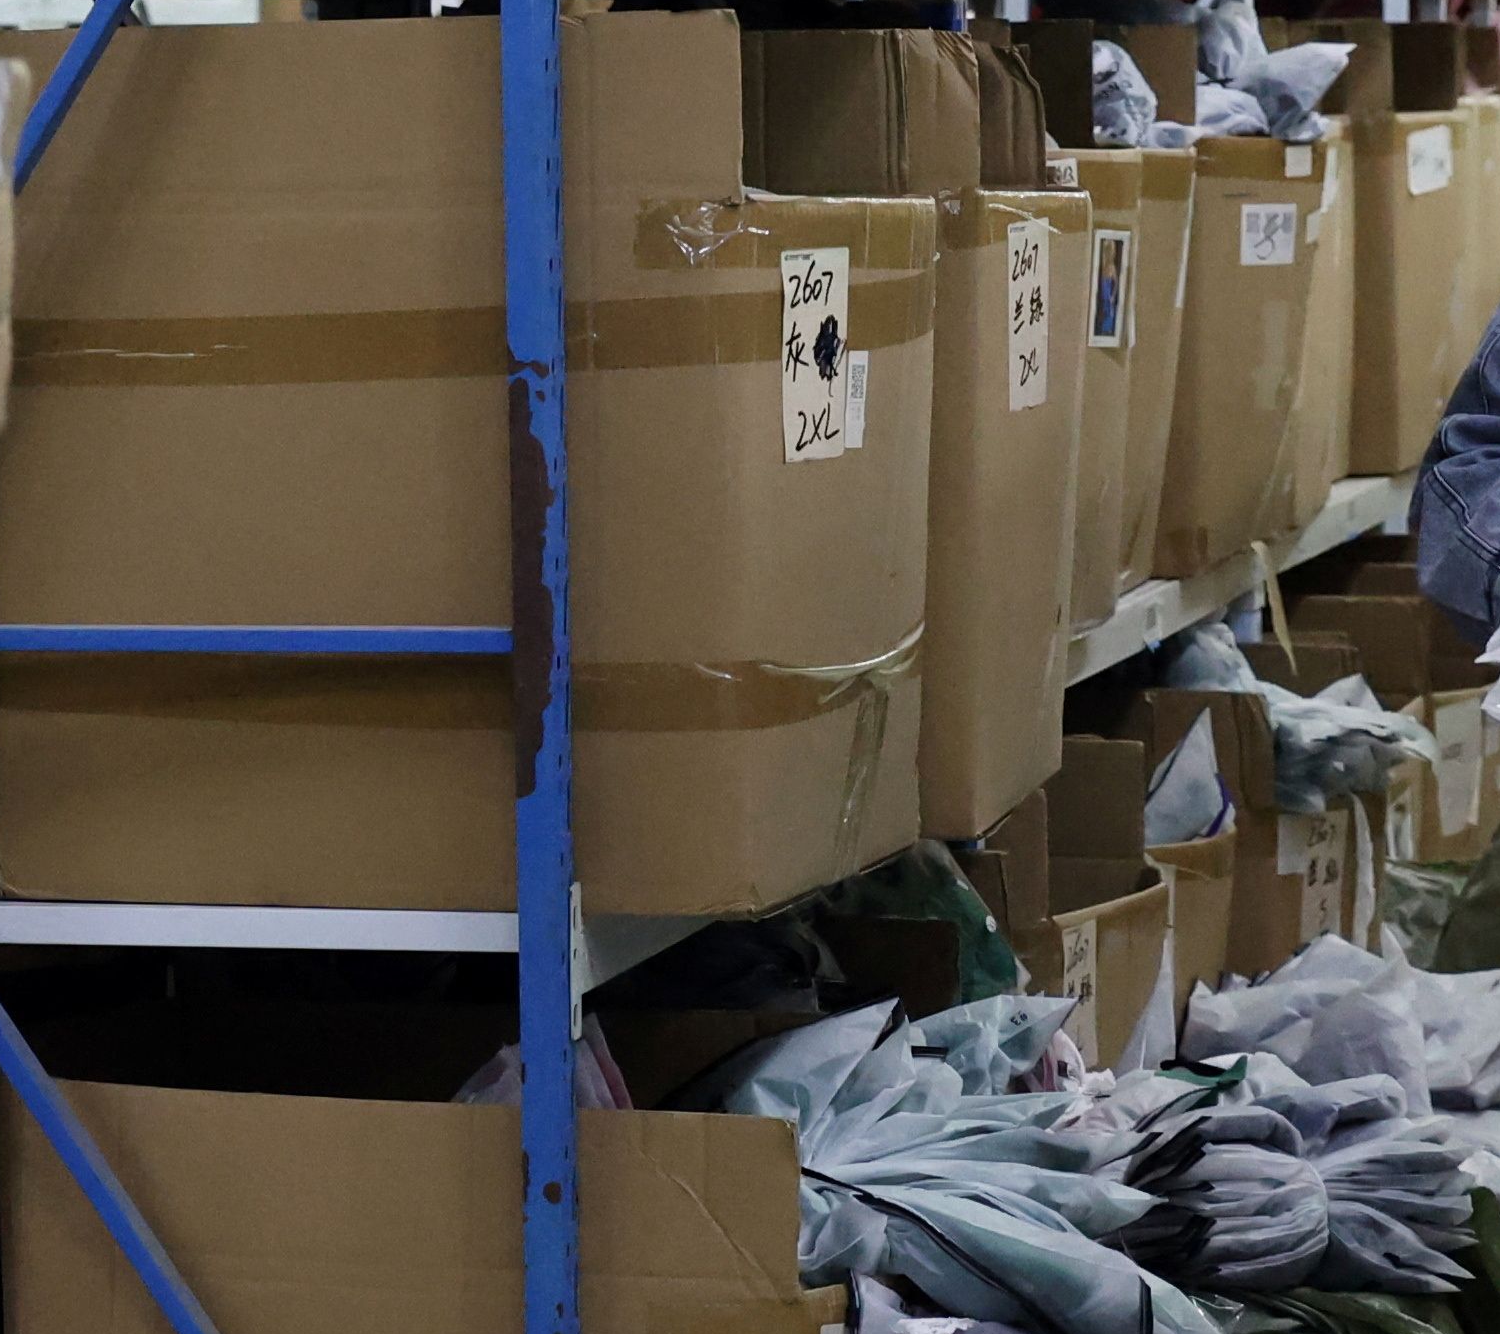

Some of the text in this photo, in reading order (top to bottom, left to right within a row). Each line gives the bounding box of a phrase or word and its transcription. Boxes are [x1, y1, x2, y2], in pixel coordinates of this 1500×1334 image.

[789, 260, 834, 309] 2607
[1012, 238, 1039, 282] 2607
[795, 402, 840, 451] 2XL
